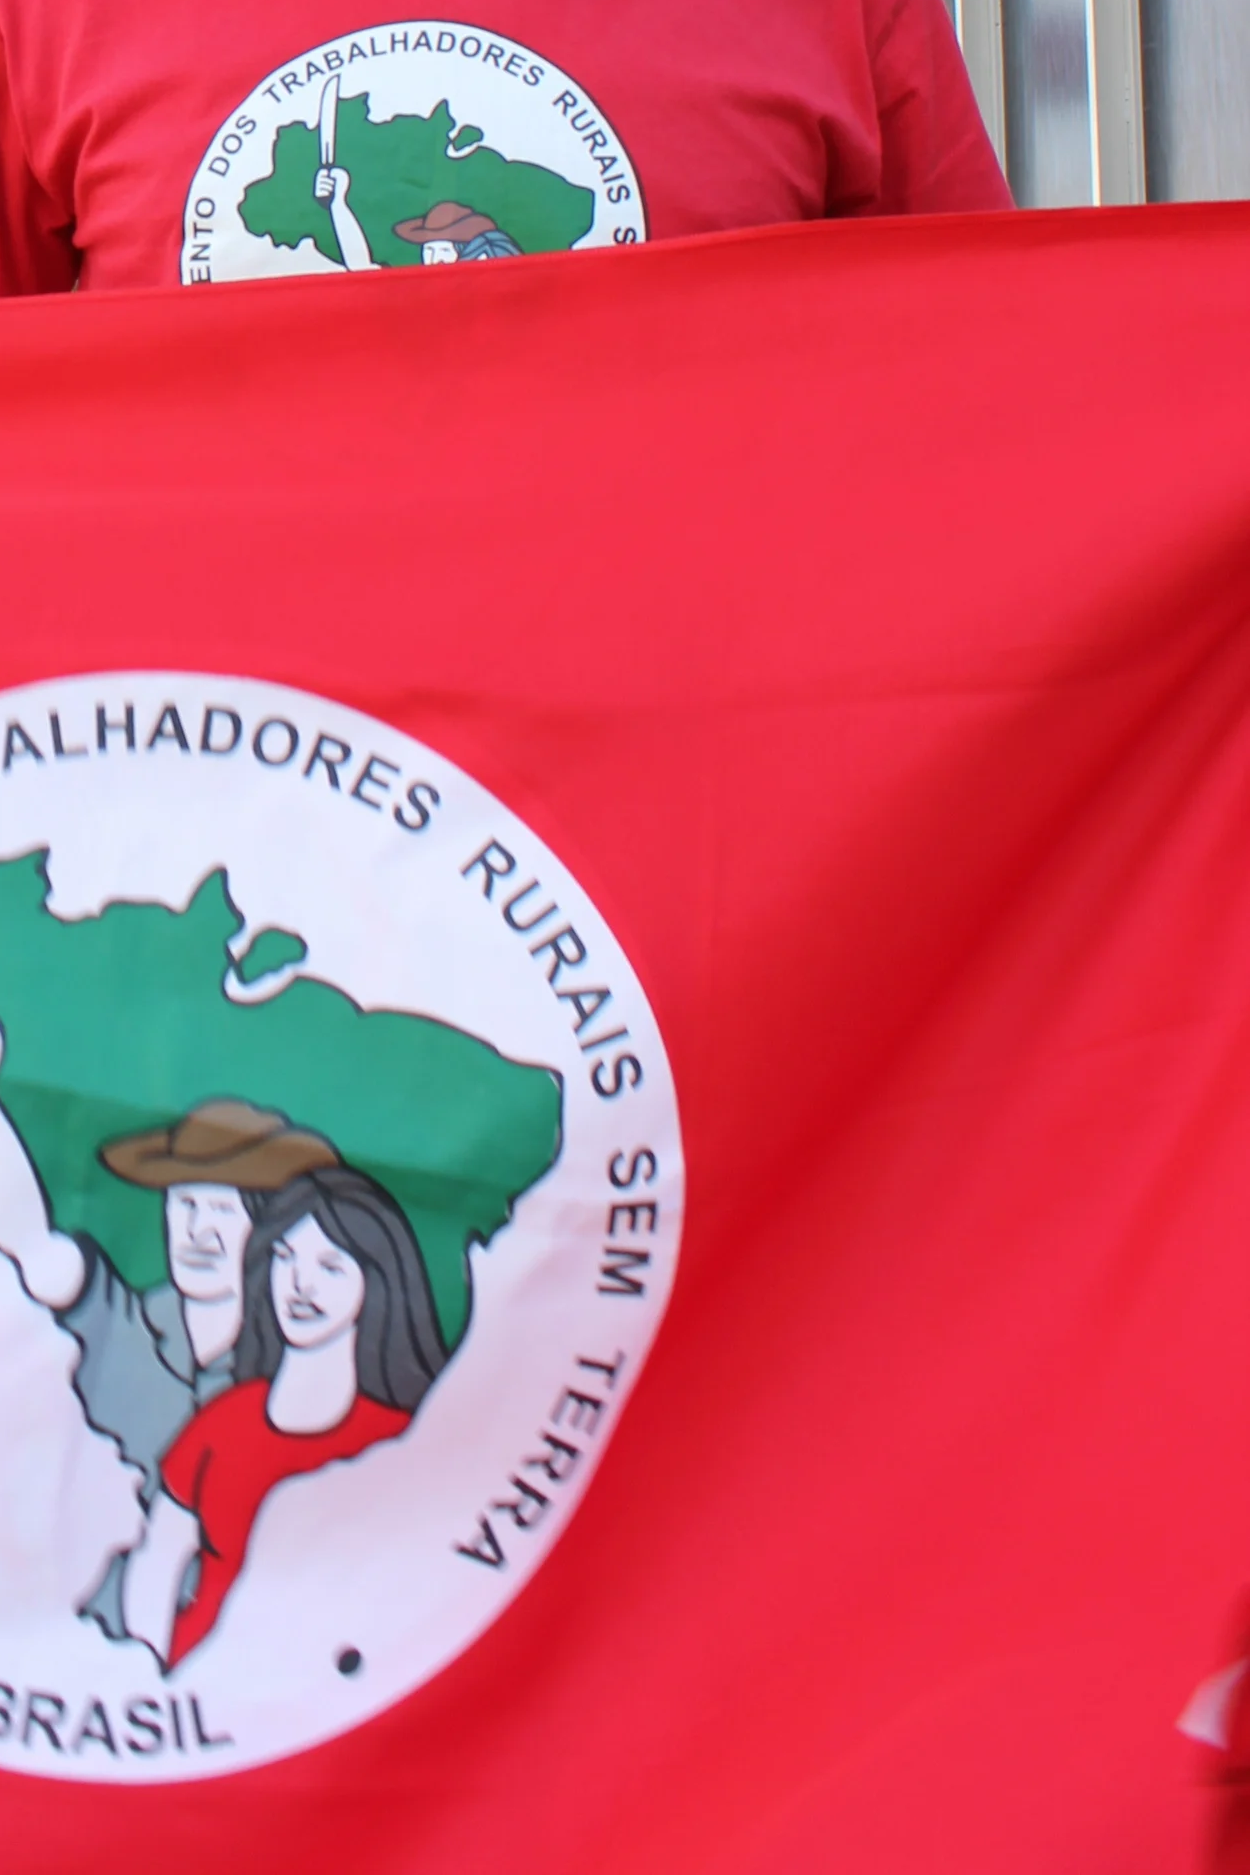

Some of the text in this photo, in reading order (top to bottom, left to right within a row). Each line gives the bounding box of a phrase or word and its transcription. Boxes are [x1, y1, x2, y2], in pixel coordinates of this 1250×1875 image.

[207, 114, 257, 178] DOS
[261, 29, 546, 105] TRABALHADORES
[552, 89, 632, 206] RURAIS
[459, 836, 644, 1101] RURAIS
[597, 1147, 659, 1300] SEM
[454, 1349, 627, 1572] TERRA
